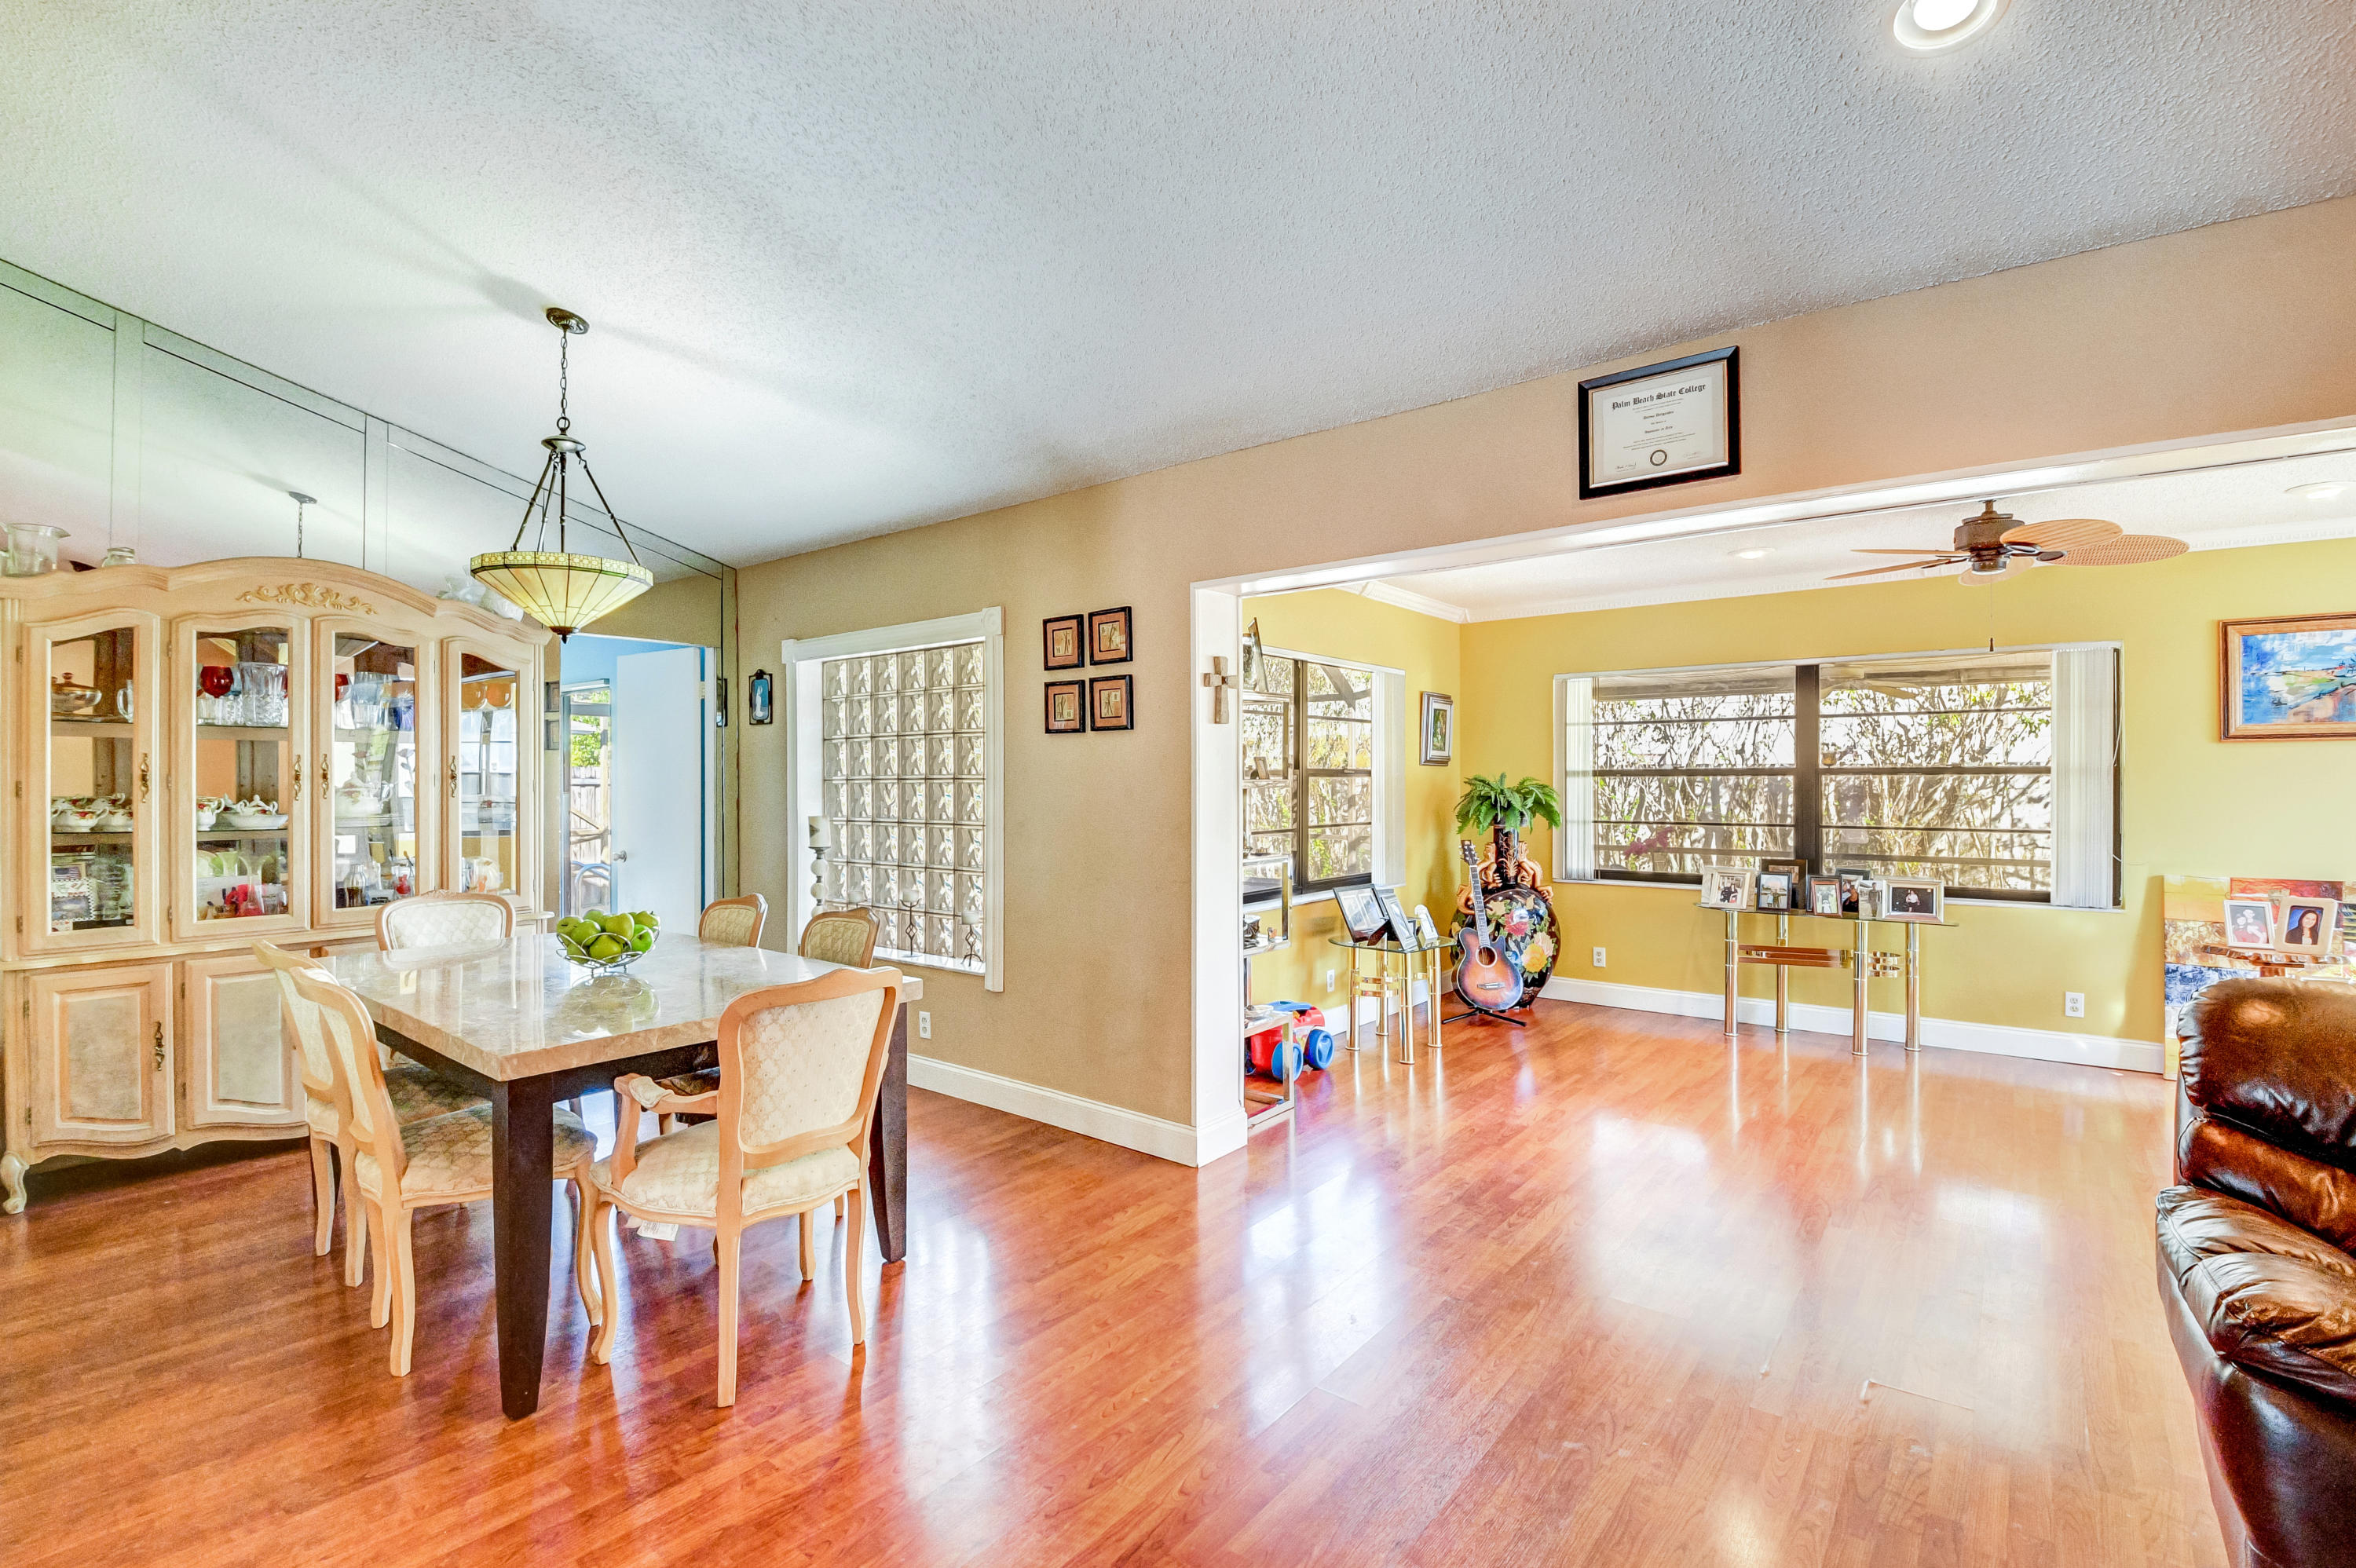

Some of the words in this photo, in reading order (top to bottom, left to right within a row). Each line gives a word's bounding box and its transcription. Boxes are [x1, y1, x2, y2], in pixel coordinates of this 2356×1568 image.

[1612, 401, 1631, 411] Palm
[1633, 395, 1654, 405] Beach
[1655, 390, 1677, 400] State
[1678, 384, 1706, 395] College
